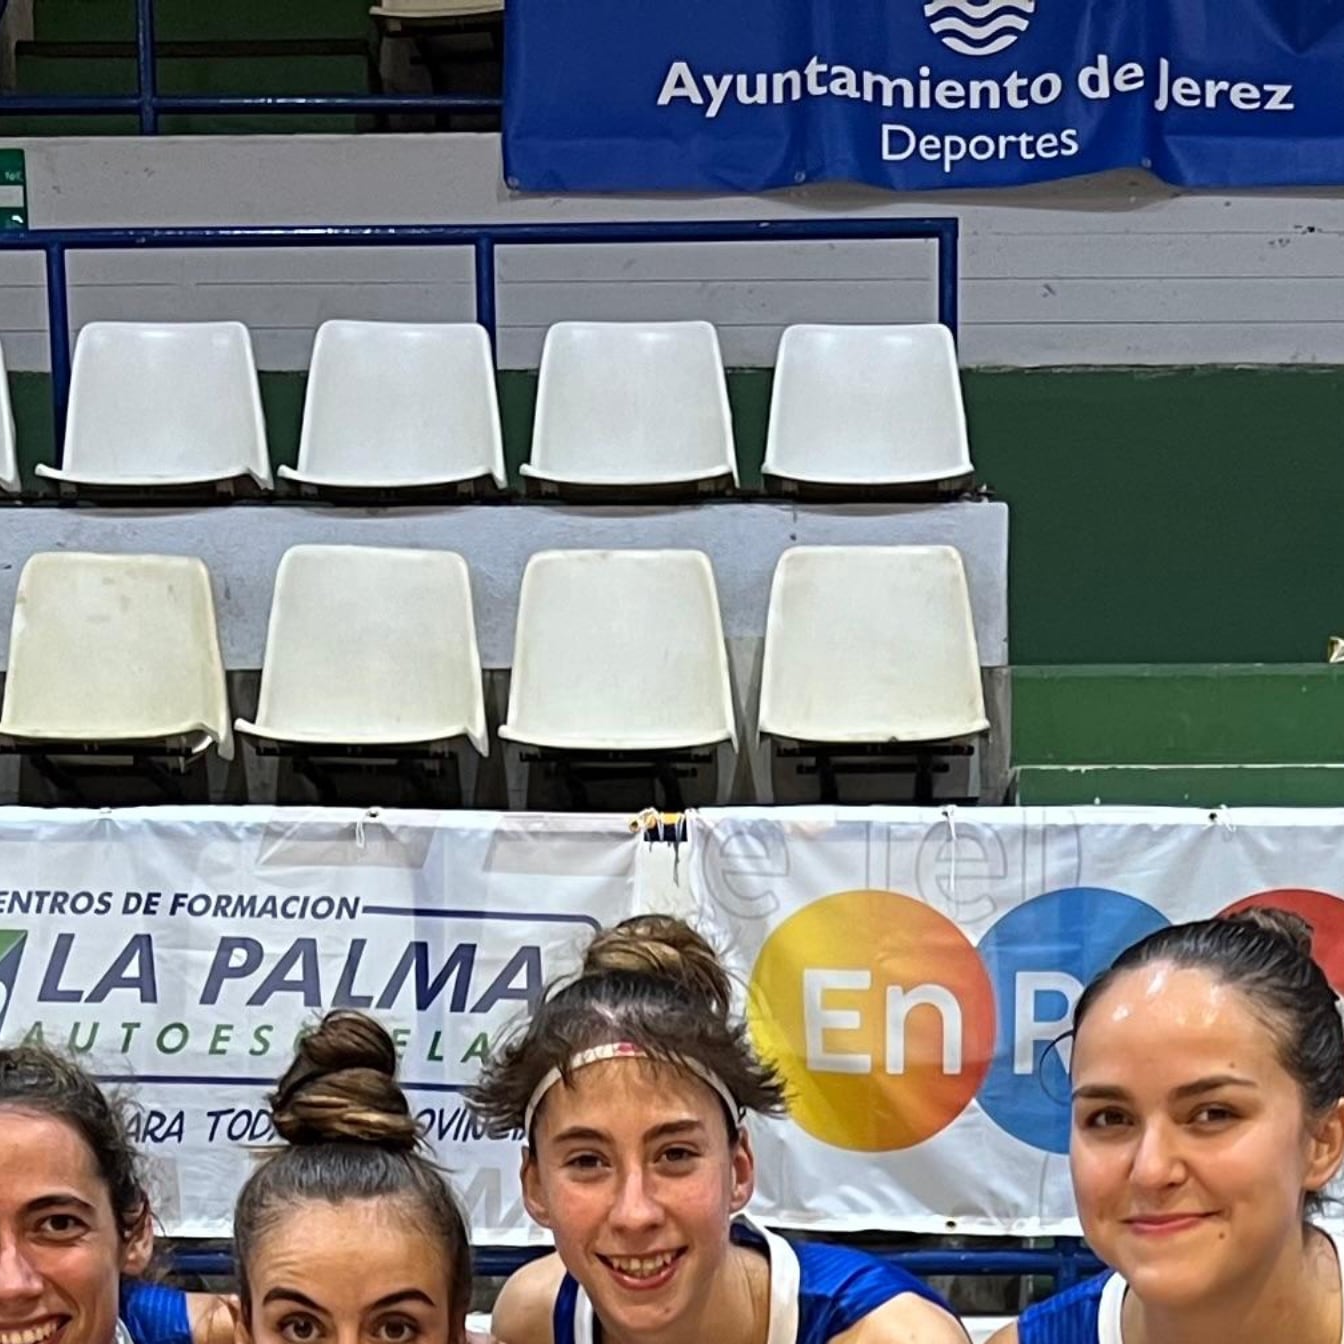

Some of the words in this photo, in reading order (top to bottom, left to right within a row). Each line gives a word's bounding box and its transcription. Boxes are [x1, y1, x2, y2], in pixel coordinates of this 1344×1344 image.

[657, 56, 1062, 117] Ayuntamiento
[1077, 54, 1144, 101] de
[1155, 57, 1295, 112] Jerez
[880, 124, 1079, 171] Deportes
[120, 891, 162, 917] DE
[169, 891, 361, 921] FORMACION
[36, 933, 157, 1004] LA
[199, 935, 545, 1014] PALMA
[21, 1019, 492, 1064] AUTOESELA
[802, 968, 963, 1075] En
[1013, 970, 1072, 1076] R
[124, 1107, 184, 1144] ARA
[206, 1107, 278, 1143] TOD
